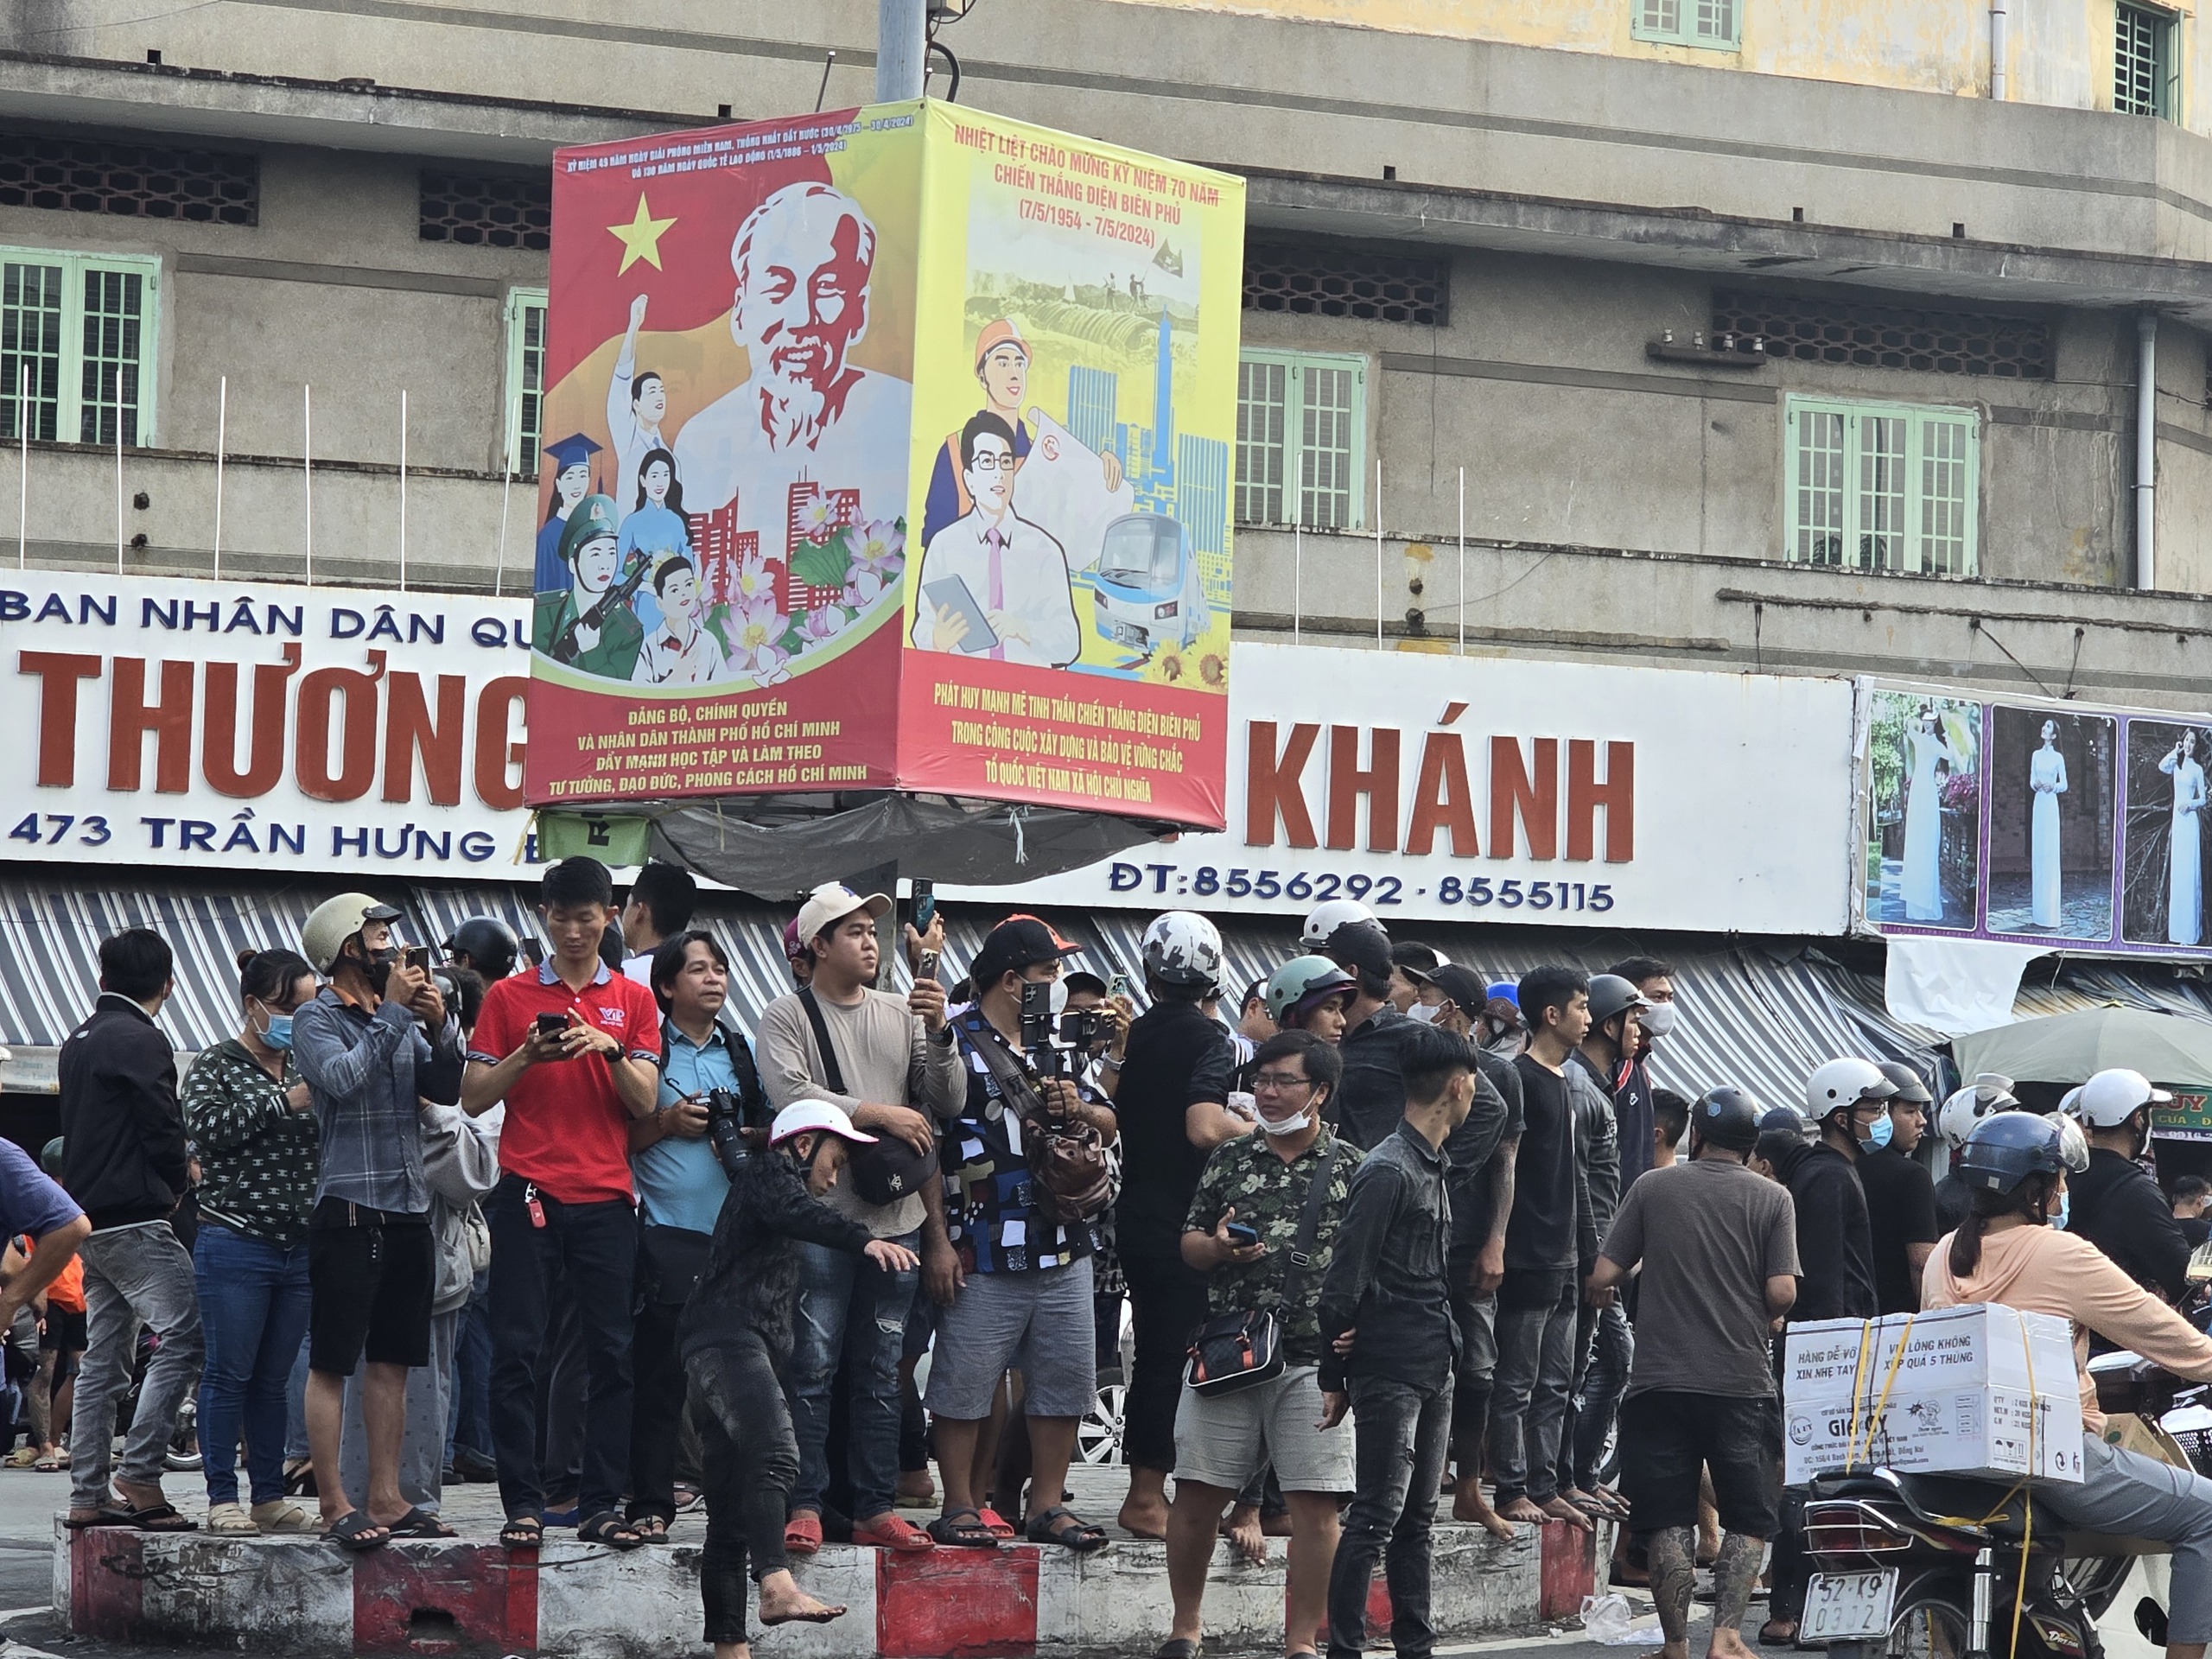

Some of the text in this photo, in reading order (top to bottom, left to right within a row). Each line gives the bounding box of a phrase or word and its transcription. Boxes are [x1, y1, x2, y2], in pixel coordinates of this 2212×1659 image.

[955, 124, 995, 154] NHIỆT
[998, 134, 1027, 162] LIỆT
[1030, 141, 1065, 168] CHÀO
[1070, 150, 1109, 181] MỪNG
[1133, 167, 1167, 195] NIỆM
[1171, 178, 1185, 199] 70
[1190, 181, 1219, 207] NĂM
[995, 162, 1181, 226] CHIẾN THẮNG ĐIỆN BIÊN PHỦ
[1020, 198, 1082, 230] (7/5/1954
[1095, 216, 1155, 249] 7/5/2024)
[0, 590, 117, 626] BAN
[141, 595, 303, 636] NHÂN
[330, 605, 444, 644] DÂN
[17, 642, 531, 810] THƯƠNG
[628, 697, 787, 726] ĐẢNG BỘ, CHÍNH QUYỀN
[934, 680, 1200, 741] PHÁT HUY MẠNH MẼ TINH THẦN CHIẾN THẮNG ĐIỆN BIÊN PHỦ
[577, 720, 840, 751] VÀ NHÂN DÂN THÀNH PHỐ HỒ CHÍ MINH
[952, 720, 1183, 772] TRONG CÔNG CUỘC XÂY DỰNG VÀ BẢO VỆ VỮNG CHẮC
[596, 744, 822, 772] ĐẨY MẠNH HỌC TẬP VÀ LÀM THEO
[986, 753, 1151, 803] TỔ QUỐC VIỆT NAM XÃ HỘI CHỦ NGHĨA
[549, 764, 867, 796] TƯ TƯỞNG, ĐẠO ĐỨC, PHONG CÁCH HỒ CHÍ MINH
[1244, 701, 1634, 862] KHÁNH
[10, 812, 111, 846] 473
[141, 808, 304, 855] TRẦN
[332, 823, 495, 862] HƯNG
[1439, 876, 1614, 912] 8555115
[599, 1007, 625, 1022] VIP
[1798, 1350, 1824, 1363] HÀNG
[1827, 1345, 1840, 1361] DỄ
[1907, 1354, 1926, 1370] QUÁ
[1929, 1356, 1936, 1365] 5
[1908, 1340, 1935, 1353] LÒNG
[1937, 1336, 1971, 1350] KHÔNG
[1796, 1364, 1855, 1380] XIN NHẸ TAY
